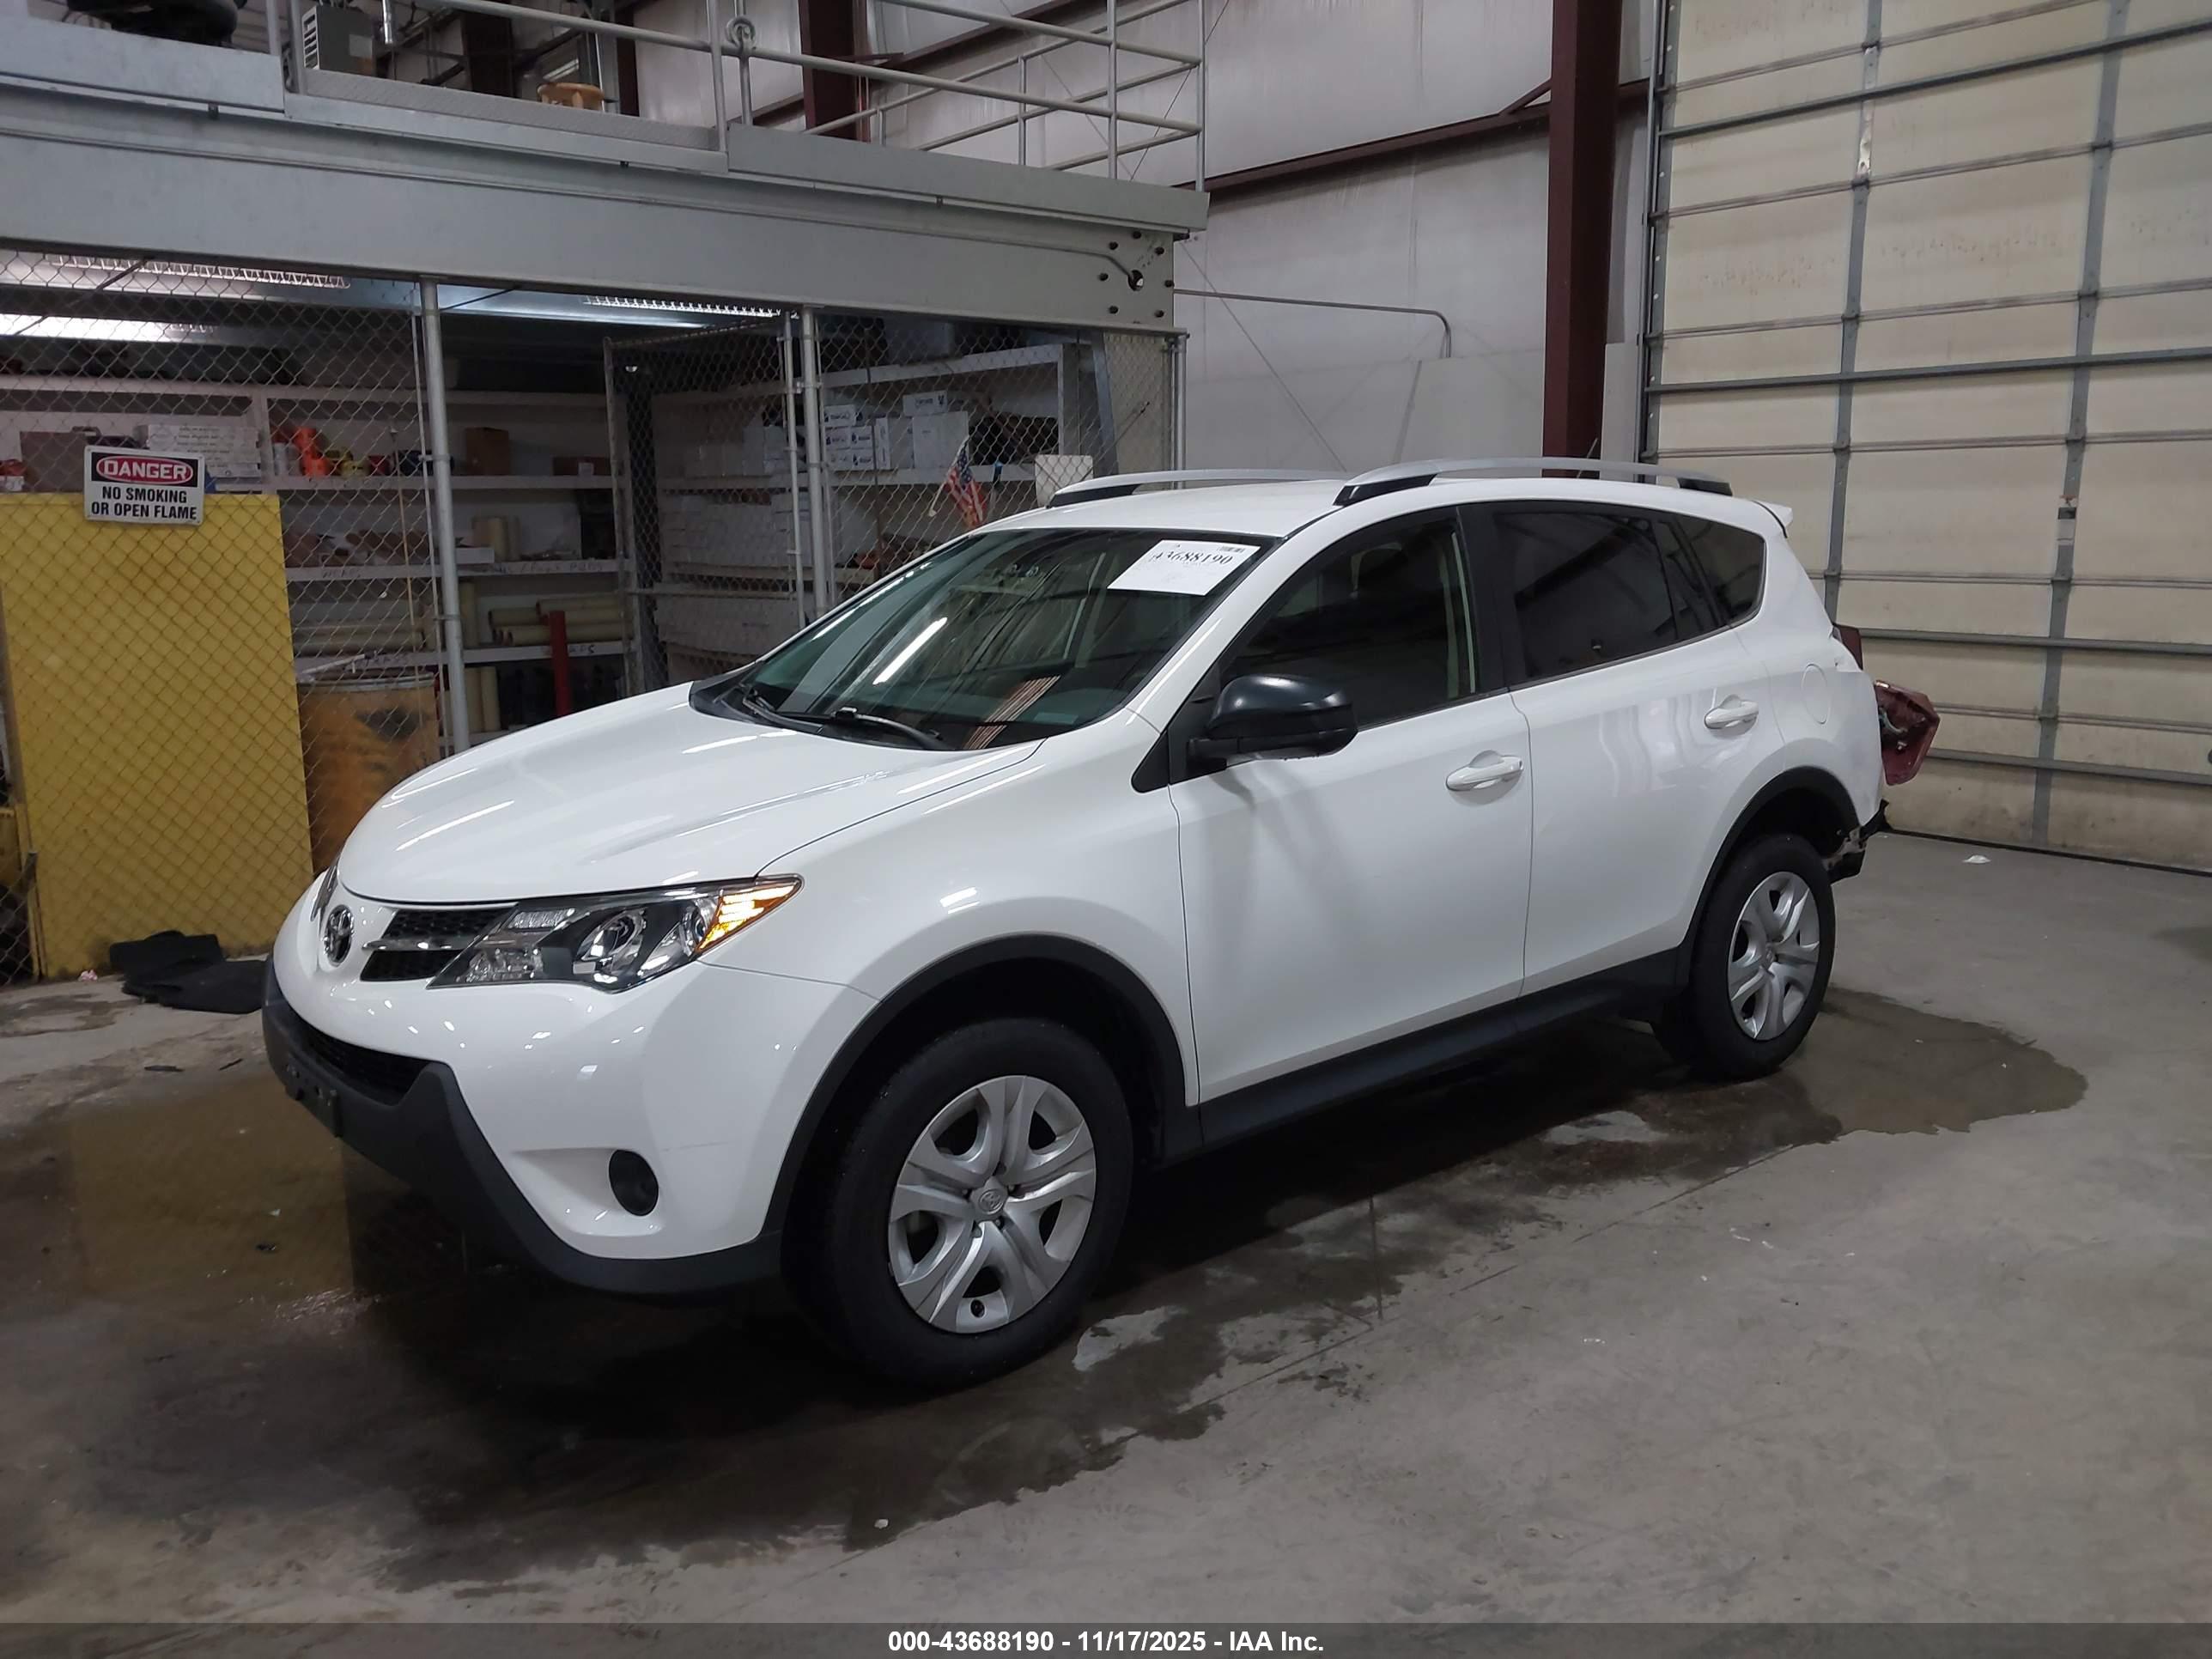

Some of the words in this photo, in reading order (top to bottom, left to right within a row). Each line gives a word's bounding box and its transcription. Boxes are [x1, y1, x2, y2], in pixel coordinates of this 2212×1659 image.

[103, 459, 187, 480] DANGER
[102, 486, 121, 500] NO
[125, 487, 187, 503] SMOKING
[91, 501, 109, 514] OR
[114, 502, 149, 518] OPEN
[154, 506, 197, 520] FLAME
